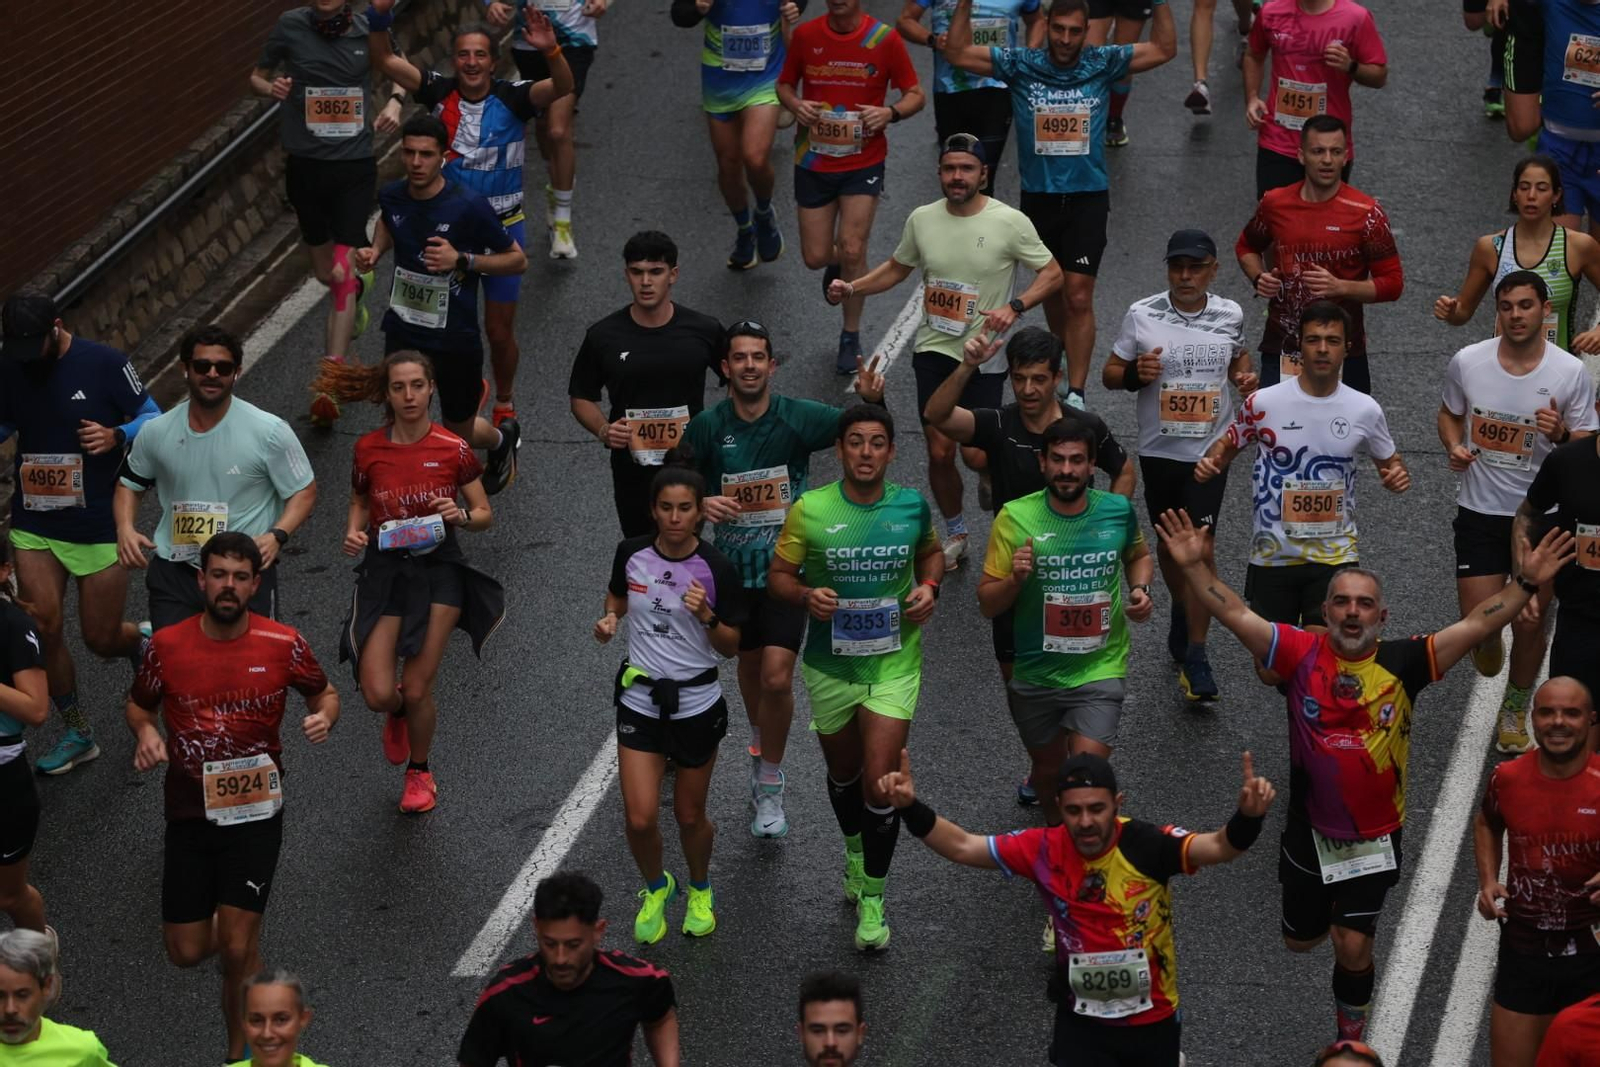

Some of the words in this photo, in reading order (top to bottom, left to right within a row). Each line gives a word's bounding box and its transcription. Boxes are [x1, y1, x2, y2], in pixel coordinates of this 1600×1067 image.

[1047, 88, 1084, 100] MEDIA
[1282, 92, 1313, 110] 4151
[315, 100, 350, 115] 3862
[817, 122, 848, 138] 6361
[1042, 117, 1078, 134] 4992
[402, 282, 434, 304] 7947
[928, 291, 962, 312] 4041
[1169, 396, 1206, 413] 5371
[637, 423, 677, 440] 4075
[1479, 422, 1520, 443] 4967
[29, 469, 66, 487] 4962
[734, 483, 774, 504] 4872
[1292, 495, 1332, 512] 5850
[175, 516, 214, 535] 12221
[825, 544, 909, 559] carrera
[1036, 550, 1117, 567] carrera
[1586, 541, 1600, 559] 4
[826, 559, 908, 571] Solidaria
[1036, 564, 1115, 581] Solidaria
[832, 573, 867, 583] contra
[868, 573, 878, 583] la
[880, 572, 899, 582] ELA
[1042, 582, 1076, 593] contra
[1079, 581, 1088, 591] la
[1091, 579, 1109, 590] ELA
[843, 612, 885, 632] 2353
[1060, 610, 1091, 627] 376
[216, 772, 264, 797] 5924
[1082, 969, 1132, 992] 8269
